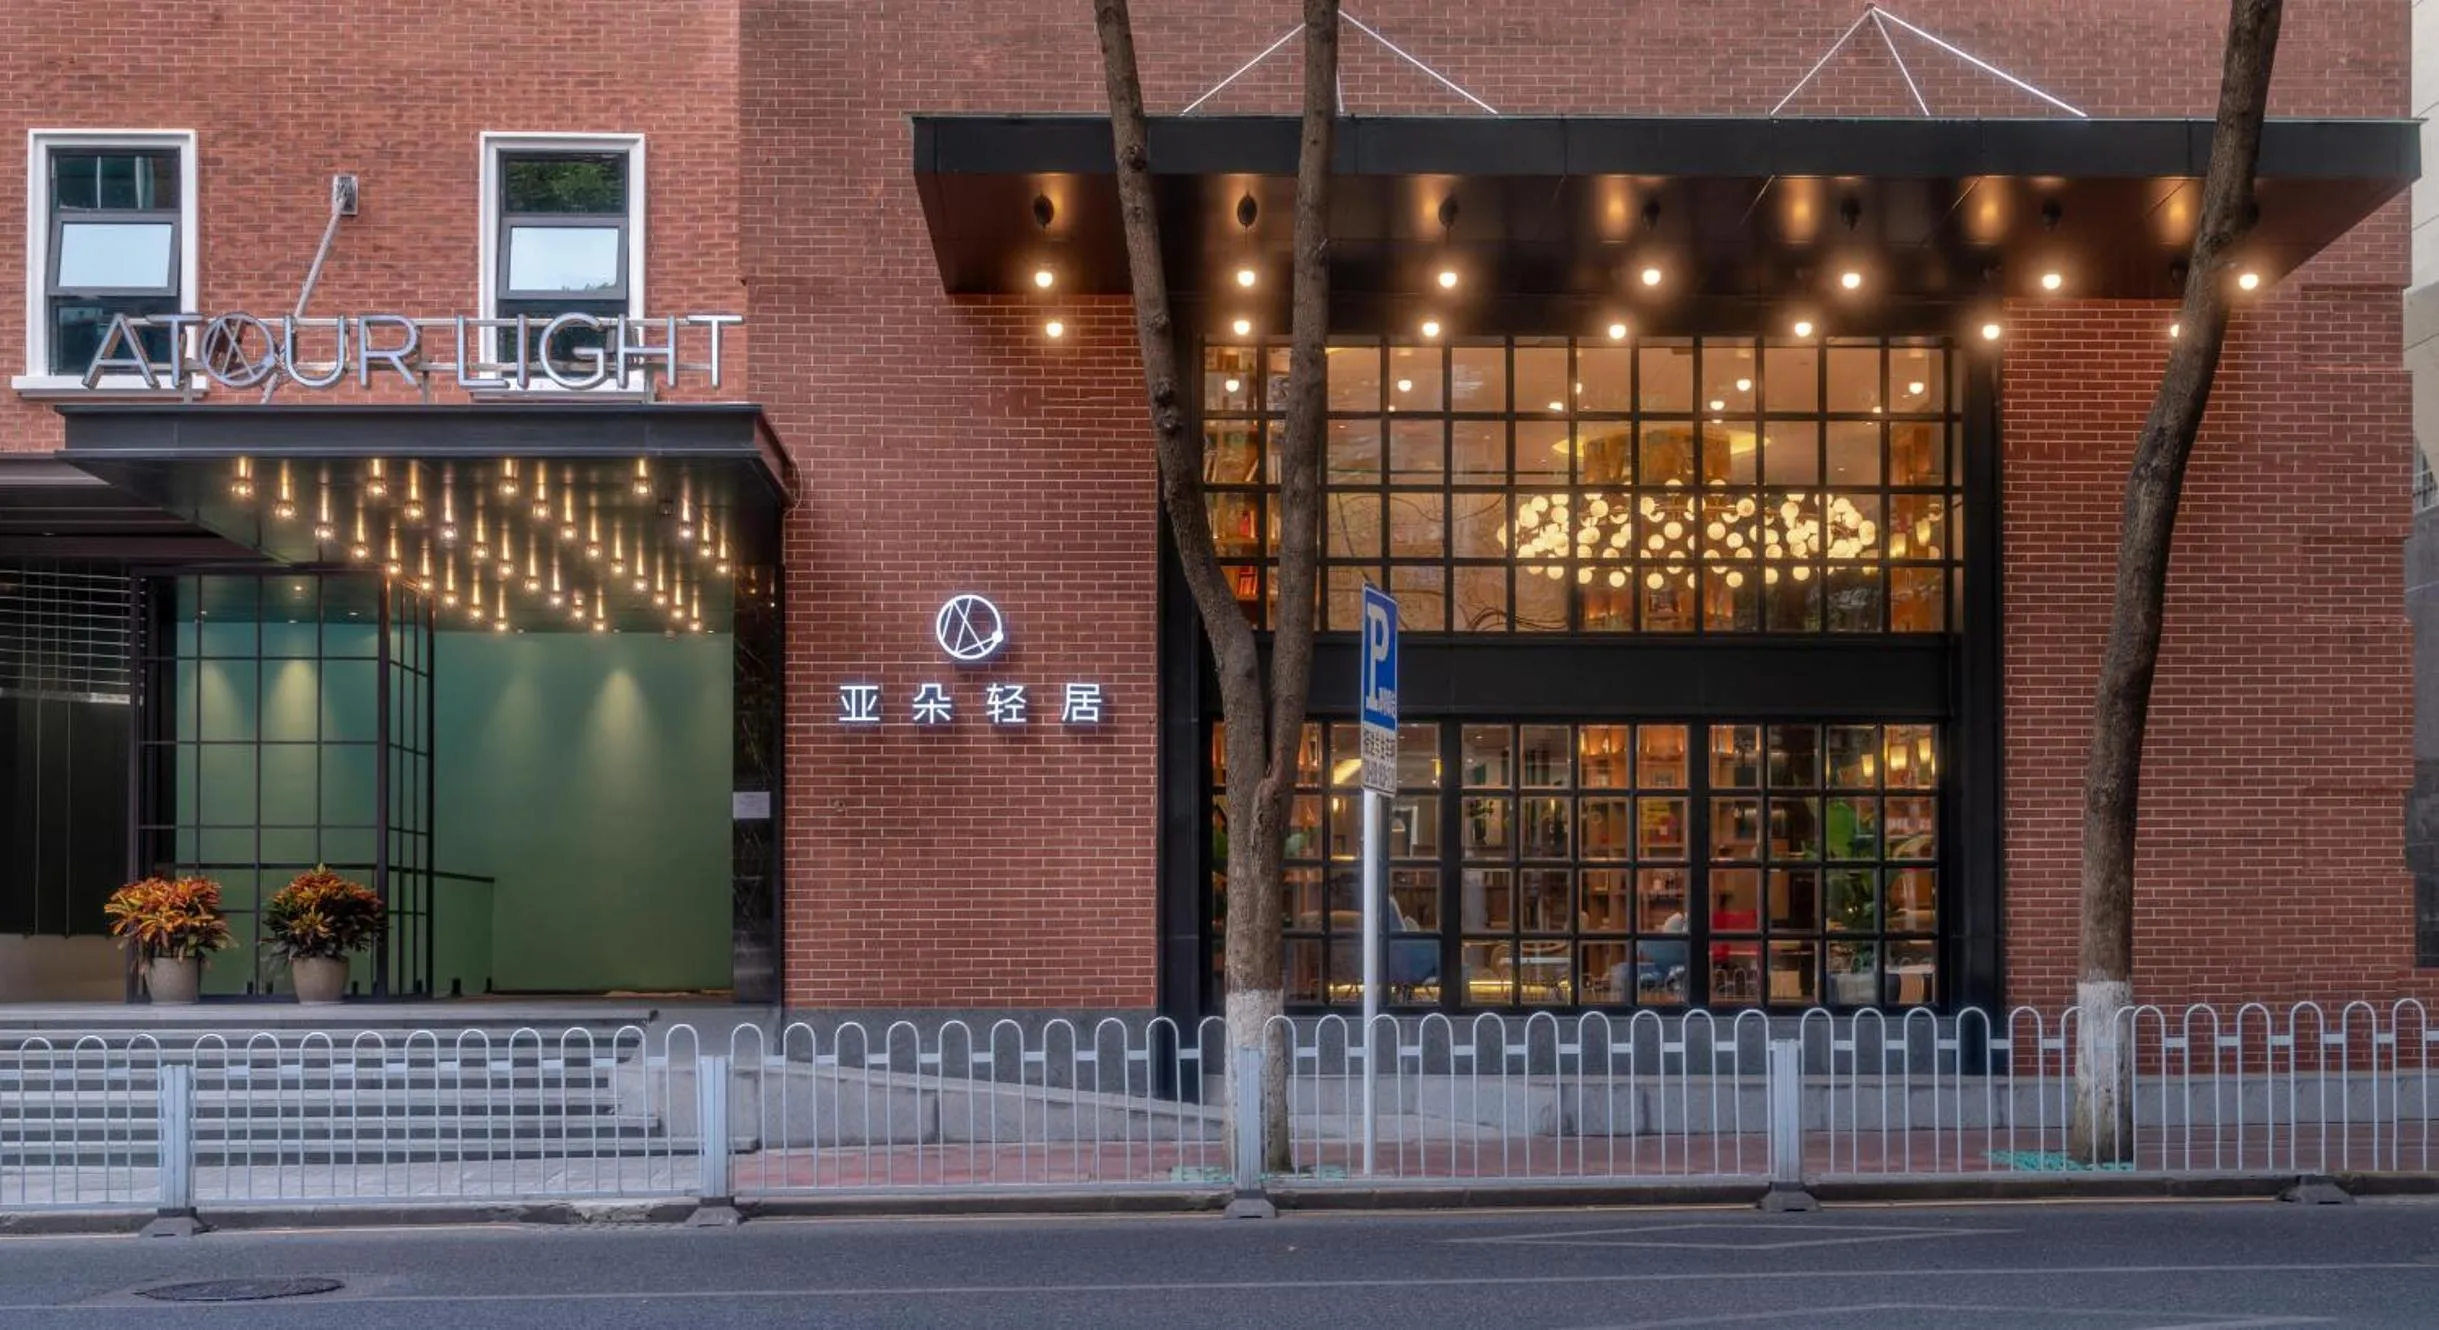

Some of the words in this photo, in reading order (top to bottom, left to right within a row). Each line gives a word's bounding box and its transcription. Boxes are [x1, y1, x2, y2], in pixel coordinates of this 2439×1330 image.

[83, 311, 419, 389] ATOUR
[456, 314, 744, 389] LIGHT
[1366, 602, 1389, 709] P
[839, 683, 1102, 724] 亚朵轻居
